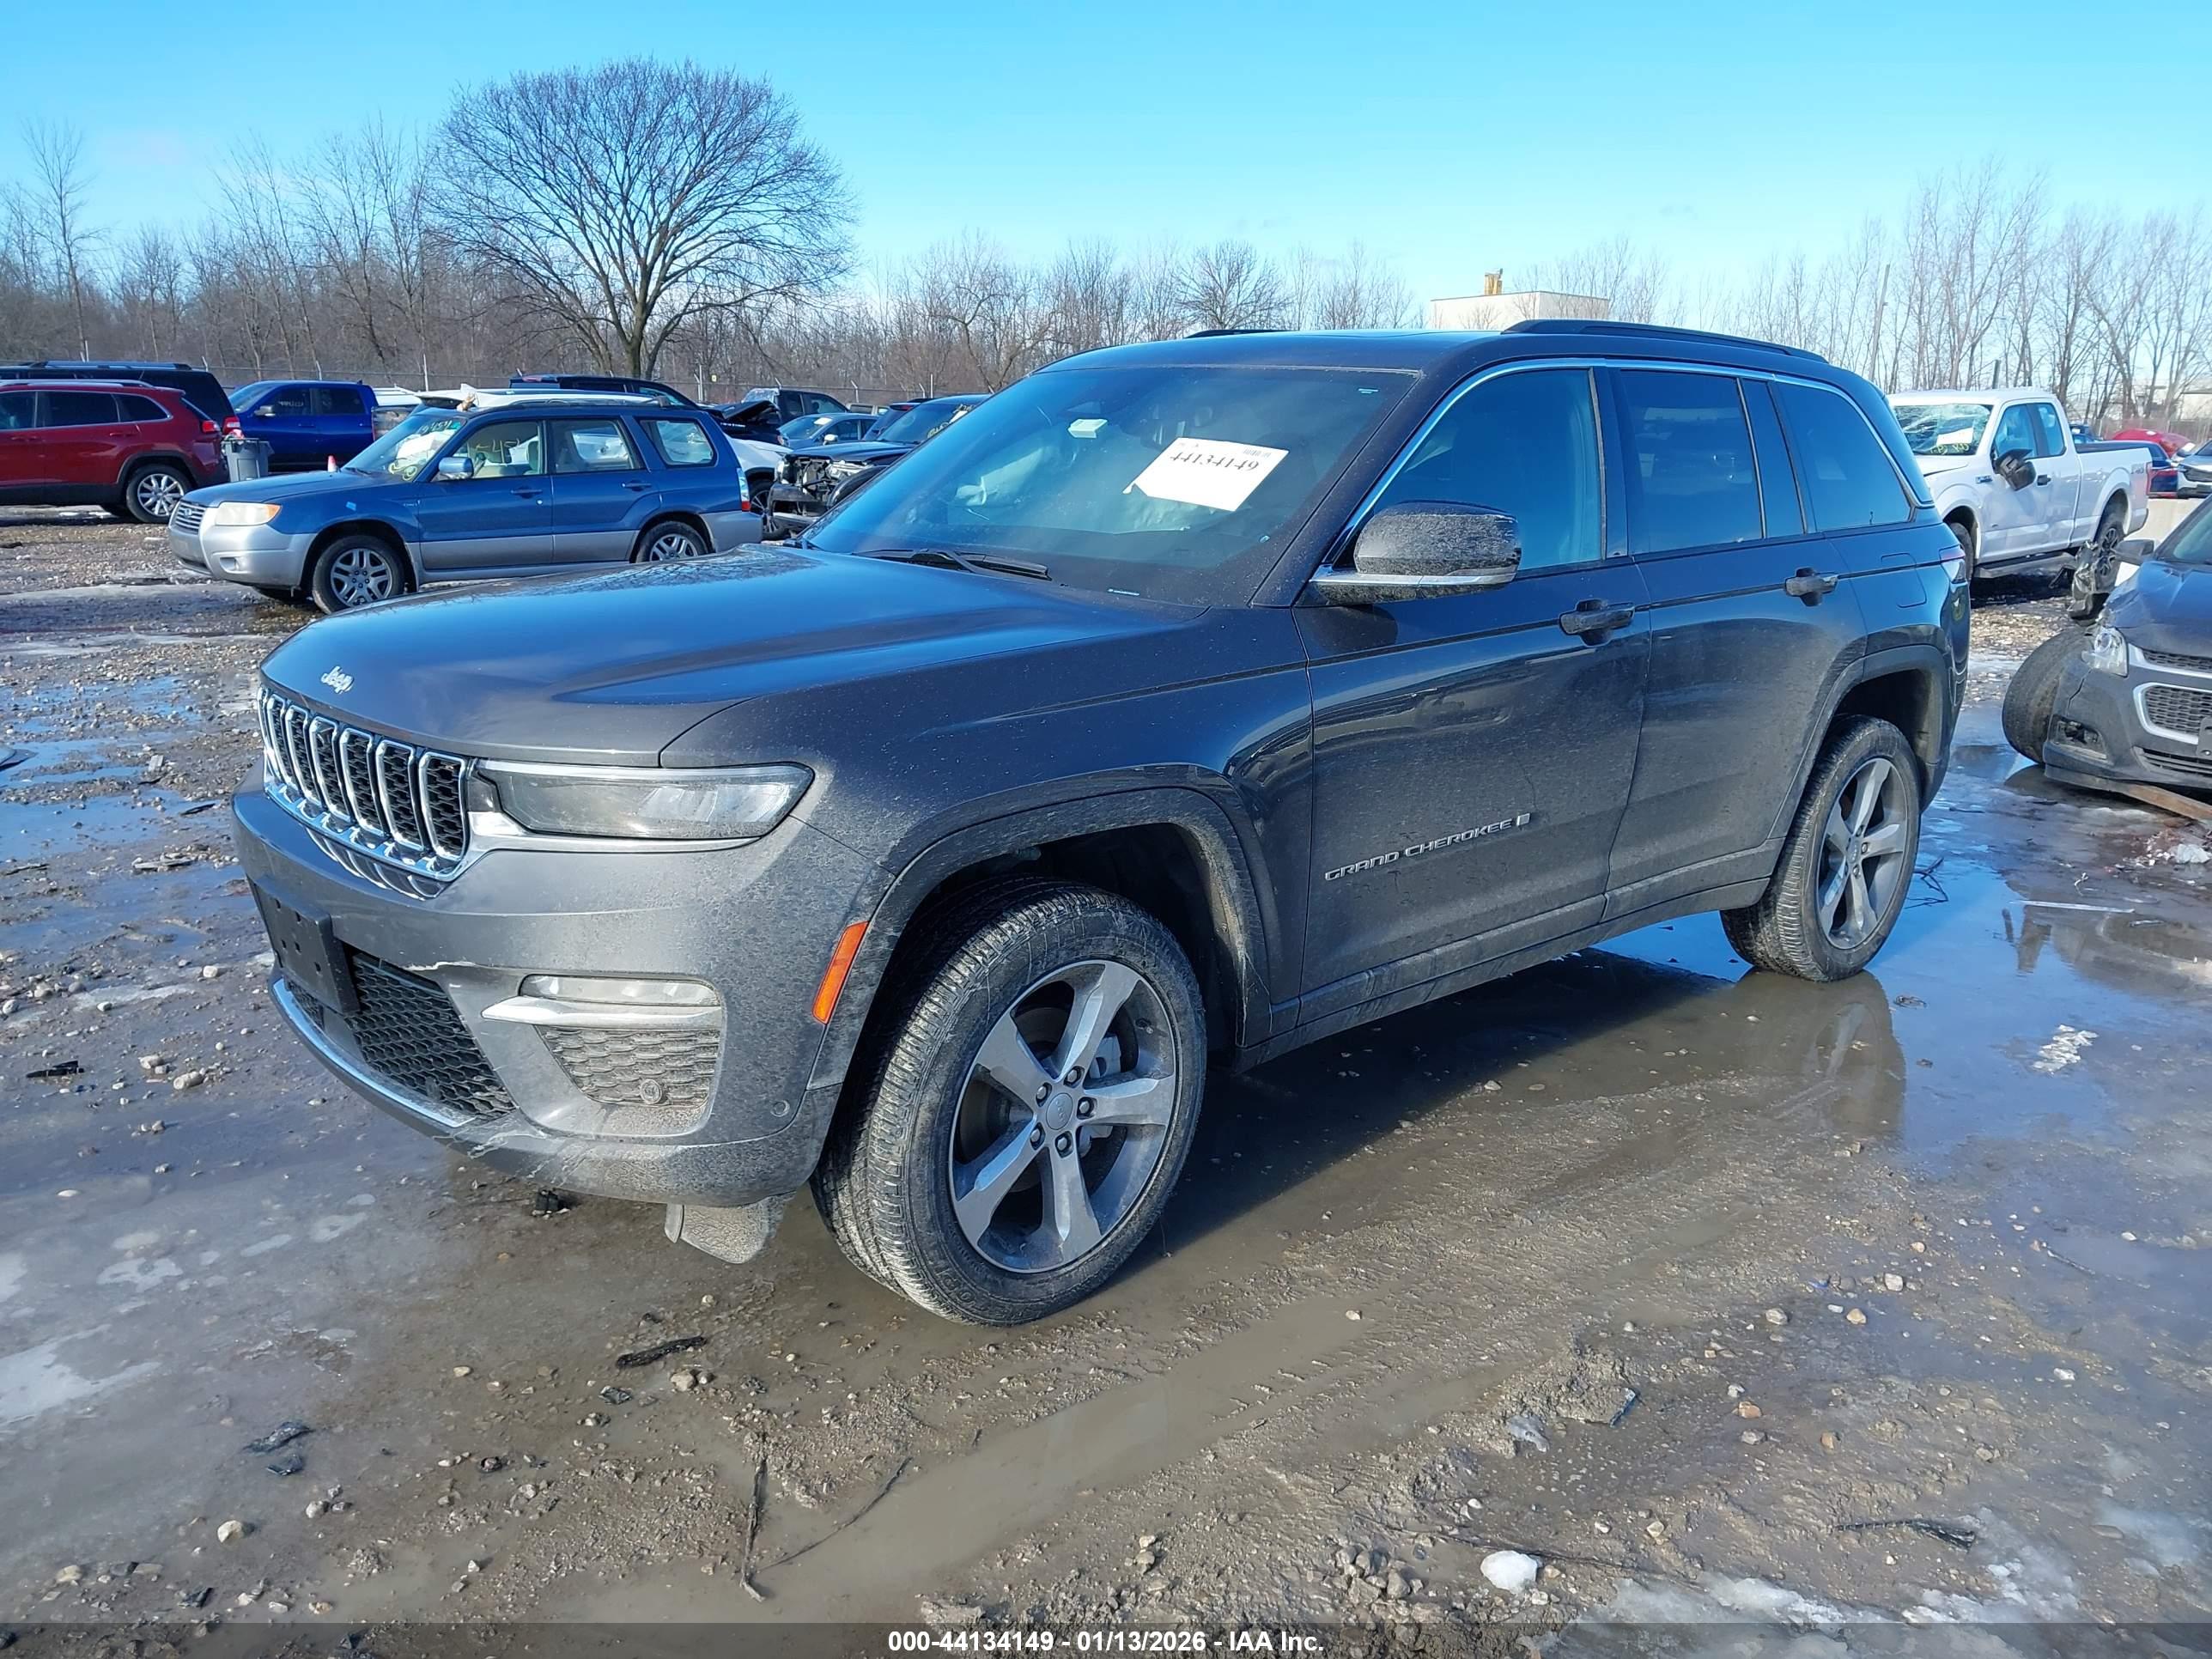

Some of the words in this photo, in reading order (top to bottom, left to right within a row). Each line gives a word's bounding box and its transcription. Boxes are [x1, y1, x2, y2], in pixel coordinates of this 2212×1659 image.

[1170, 451, 1260, 471] 44134149
[320, 665, 354, 694] Jeep
[1324, 850, 1401, 882] GRAND
[1404, 817, 1513, 858] CHEROKEE
